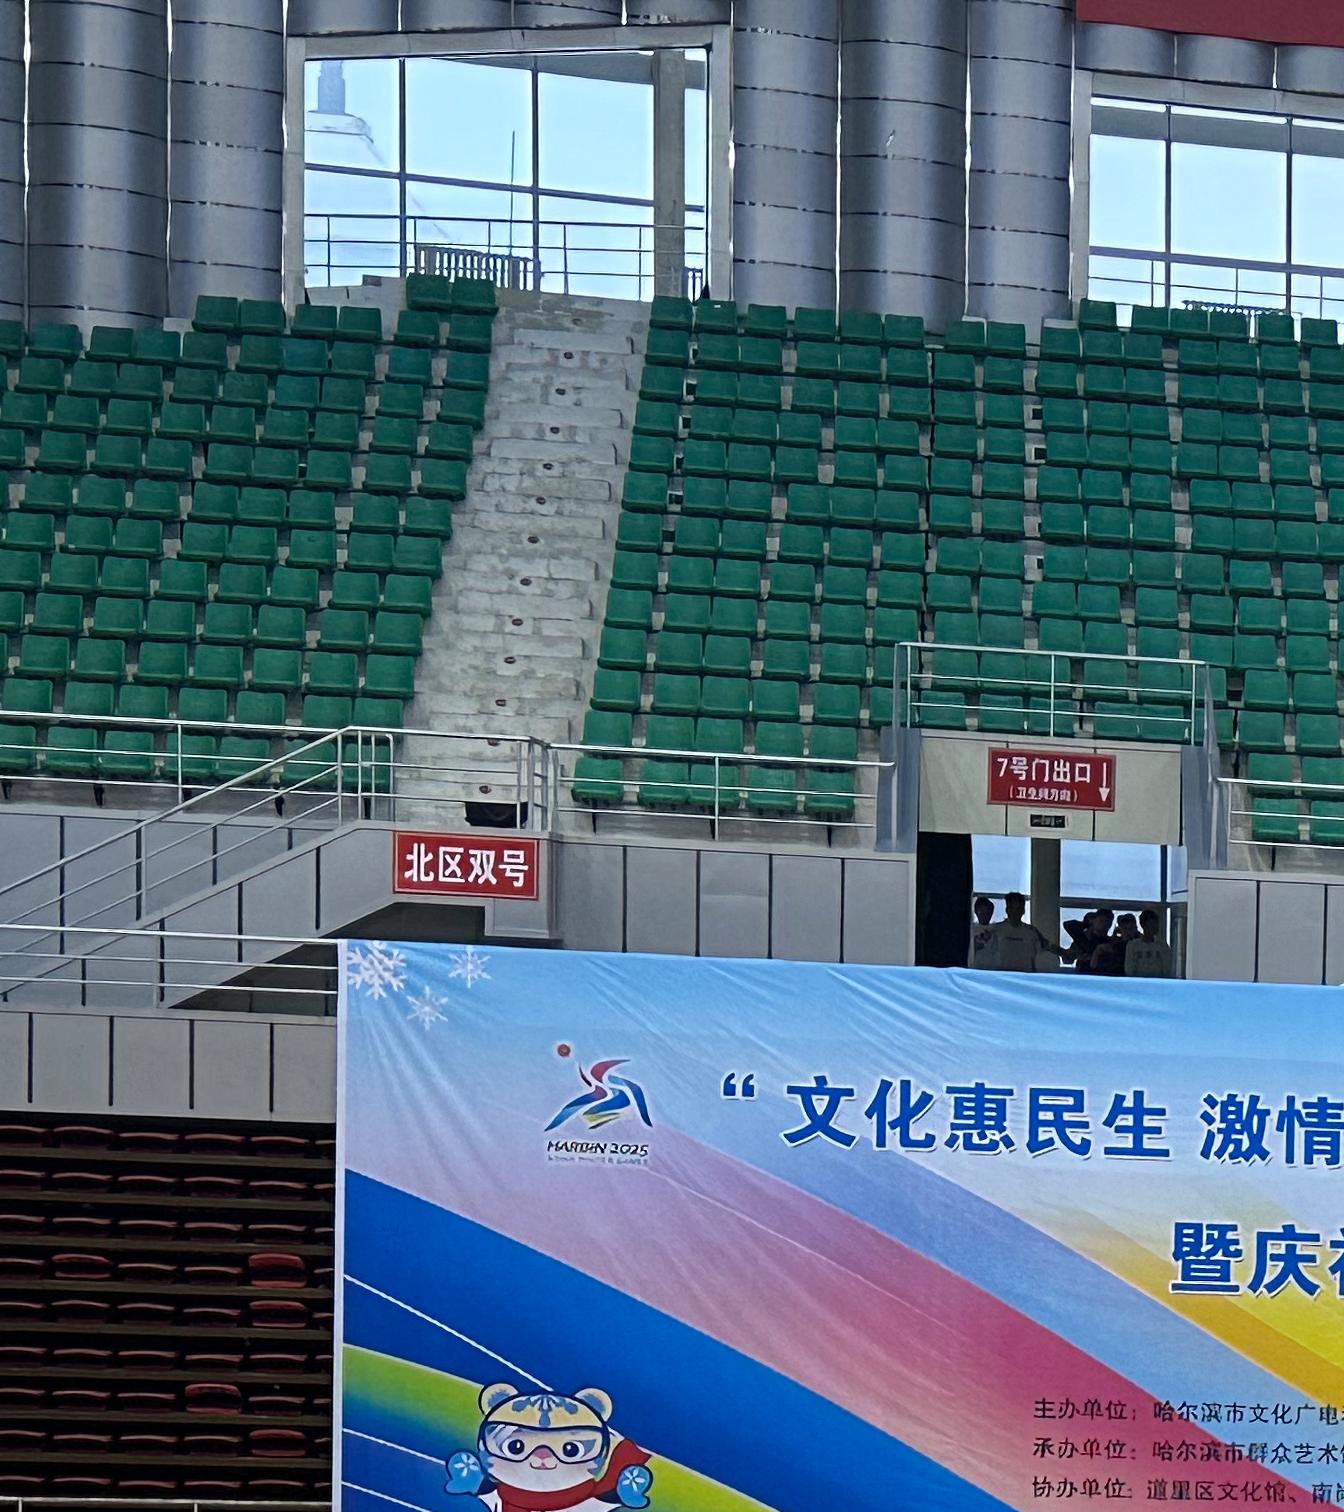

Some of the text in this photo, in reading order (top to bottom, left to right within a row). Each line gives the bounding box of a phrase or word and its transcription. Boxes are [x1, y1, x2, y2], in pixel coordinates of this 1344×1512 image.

[997, 756, 1091, 783] 7号门出口
[404, 842, 529, 887] 北区双号
[610, 1143, 649, 1157] 2025
